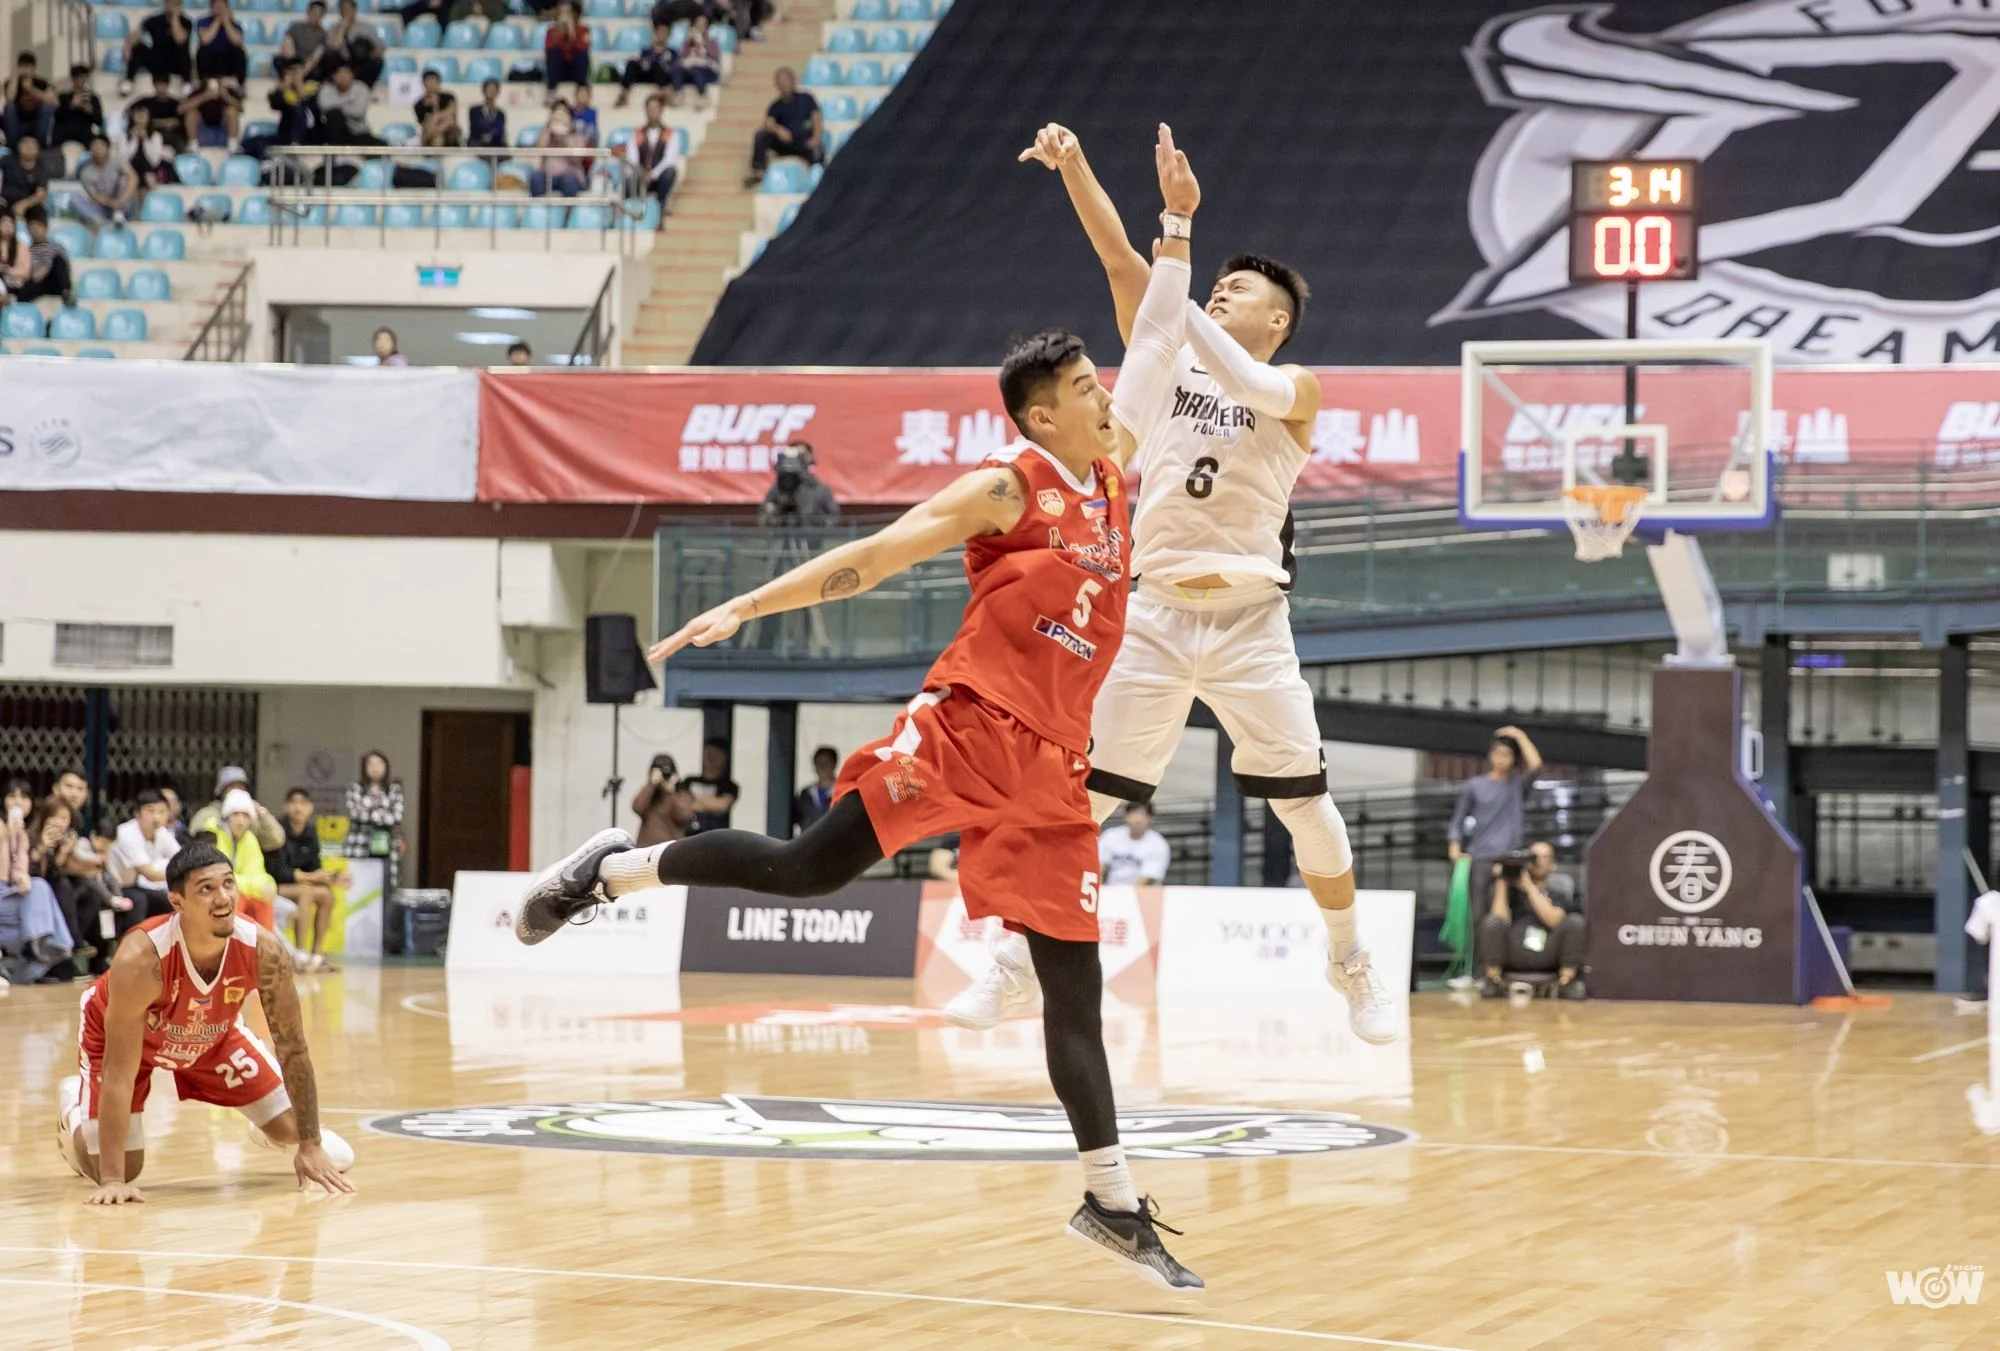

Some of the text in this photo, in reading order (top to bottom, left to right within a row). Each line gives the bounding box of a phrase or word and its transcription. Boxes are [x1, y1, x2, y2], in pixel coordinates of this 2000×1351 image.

[681, 403, 816, 443] BUFF
[1310, 408, 1420, 464] 泰山
[1185, 456, 1219, 499] 6
[1072, 578, 1103, 628] 5
[1079, 871, 1098, 913] 5
[1665, 841, 1718, 903] 春
[727, 907, 874, 944] LINE TODAY
[1617, 924, 1763, 948] CHUN YANG
[215, 1047, 259, 1089] 25
